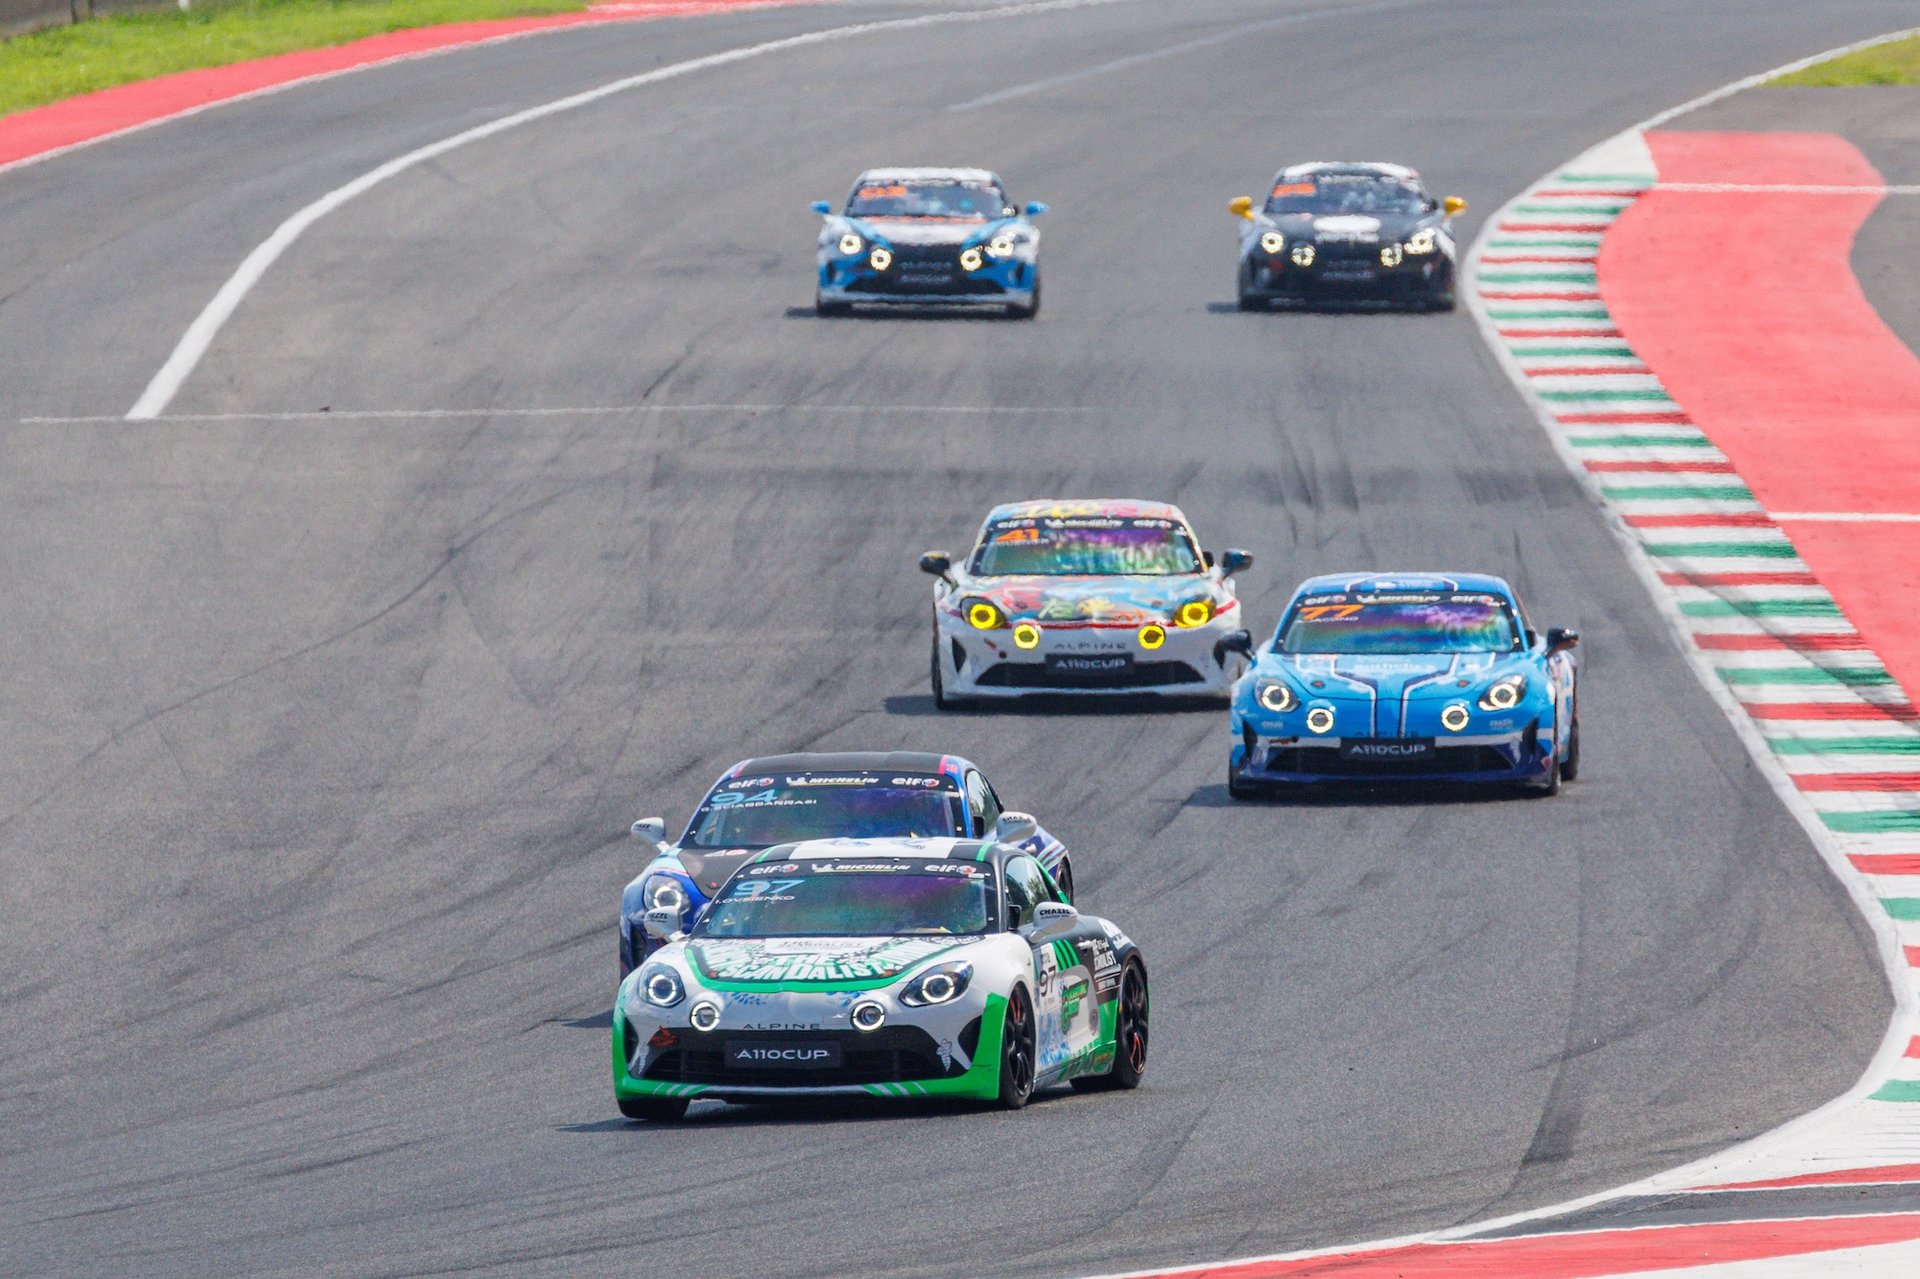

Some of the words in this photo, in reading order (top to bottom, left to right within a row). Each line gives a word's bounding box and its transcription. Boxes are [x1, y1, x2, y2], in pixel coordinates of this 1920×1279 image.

[995, 529, 1039, 542] 41
[1300, 604, 1364, 621] 77
[809, 777, 879, 785] MICHELIN
[710, 789, 778, 807] 94
[750, 863, 783, 875] elf
[924, 863, 957, 873] elf
[734, 880, 806, 896] 97
[1039, 965, 1057, 998] 97
[743, 1023, 821, 1031] ALPINE
[735, 1048, 830, 1060] A110CUP
